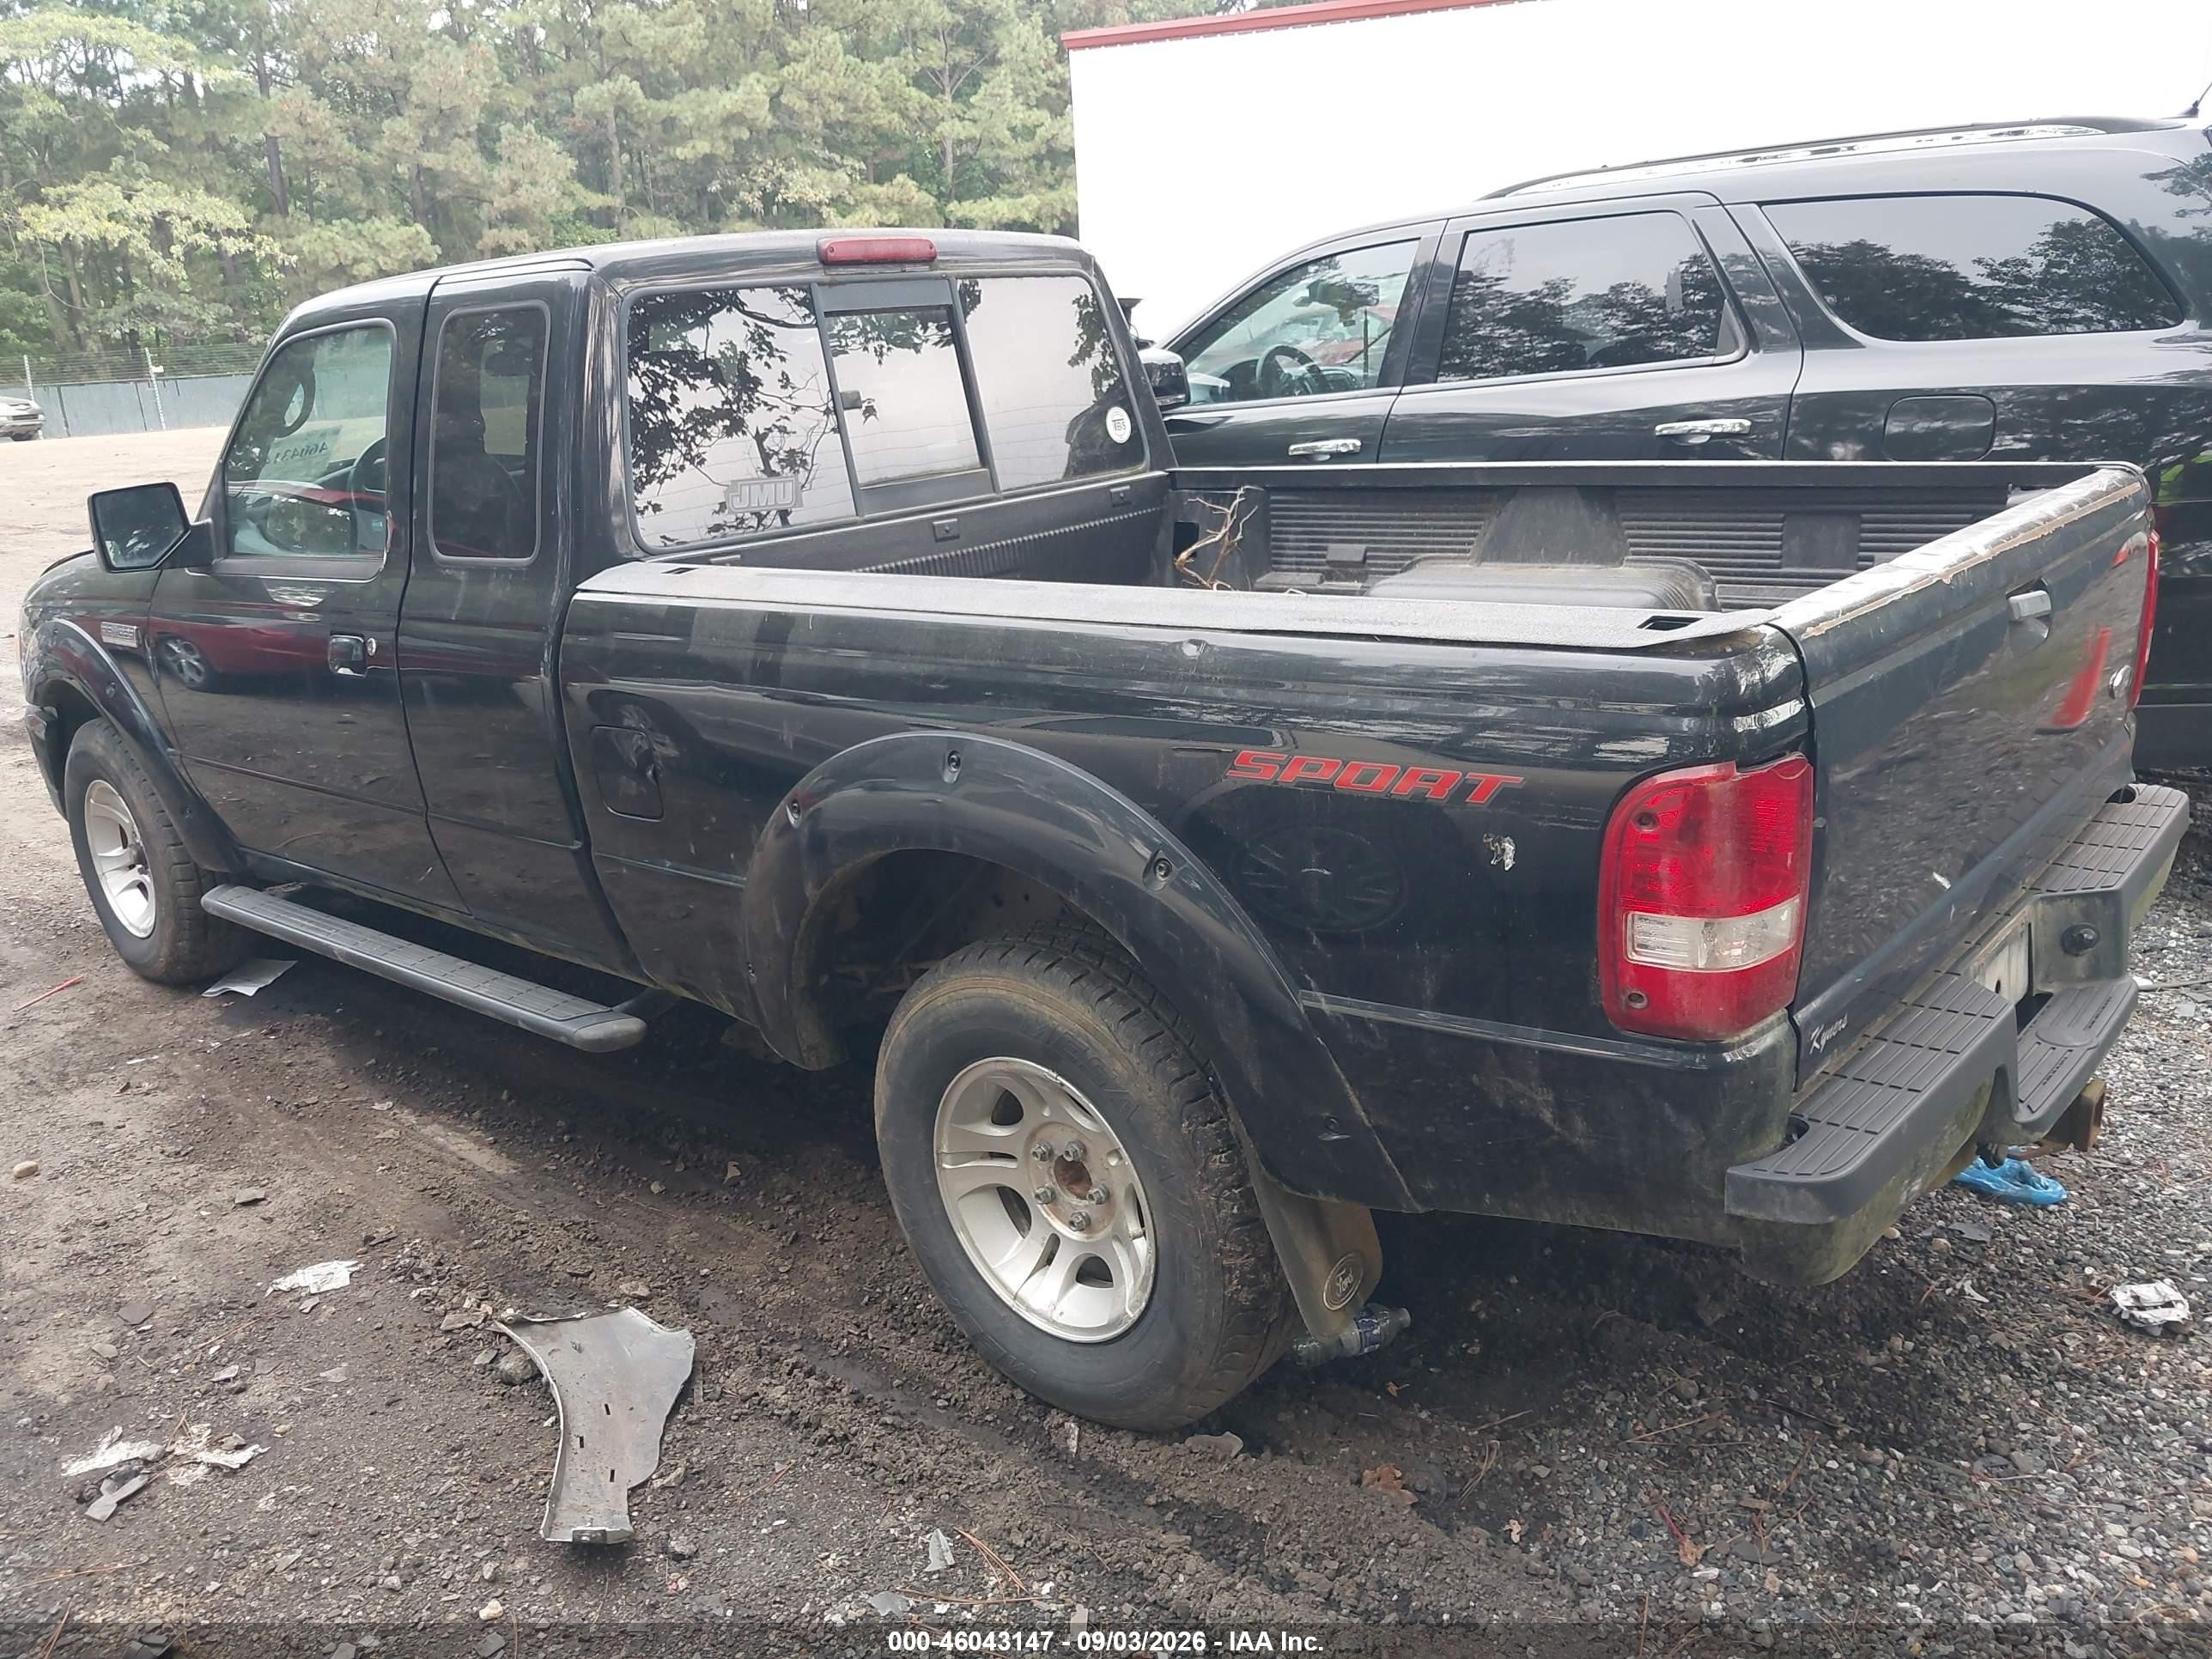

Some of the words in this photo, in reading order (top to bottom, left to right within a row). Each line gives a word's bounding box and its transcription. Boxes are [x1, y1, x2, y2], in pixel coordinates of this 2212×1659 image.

[730, 479, 794, 511] JMU
[1226, 750, 1525, 804] SPORT
[1334, 1267, 1354, 1297] Ford
